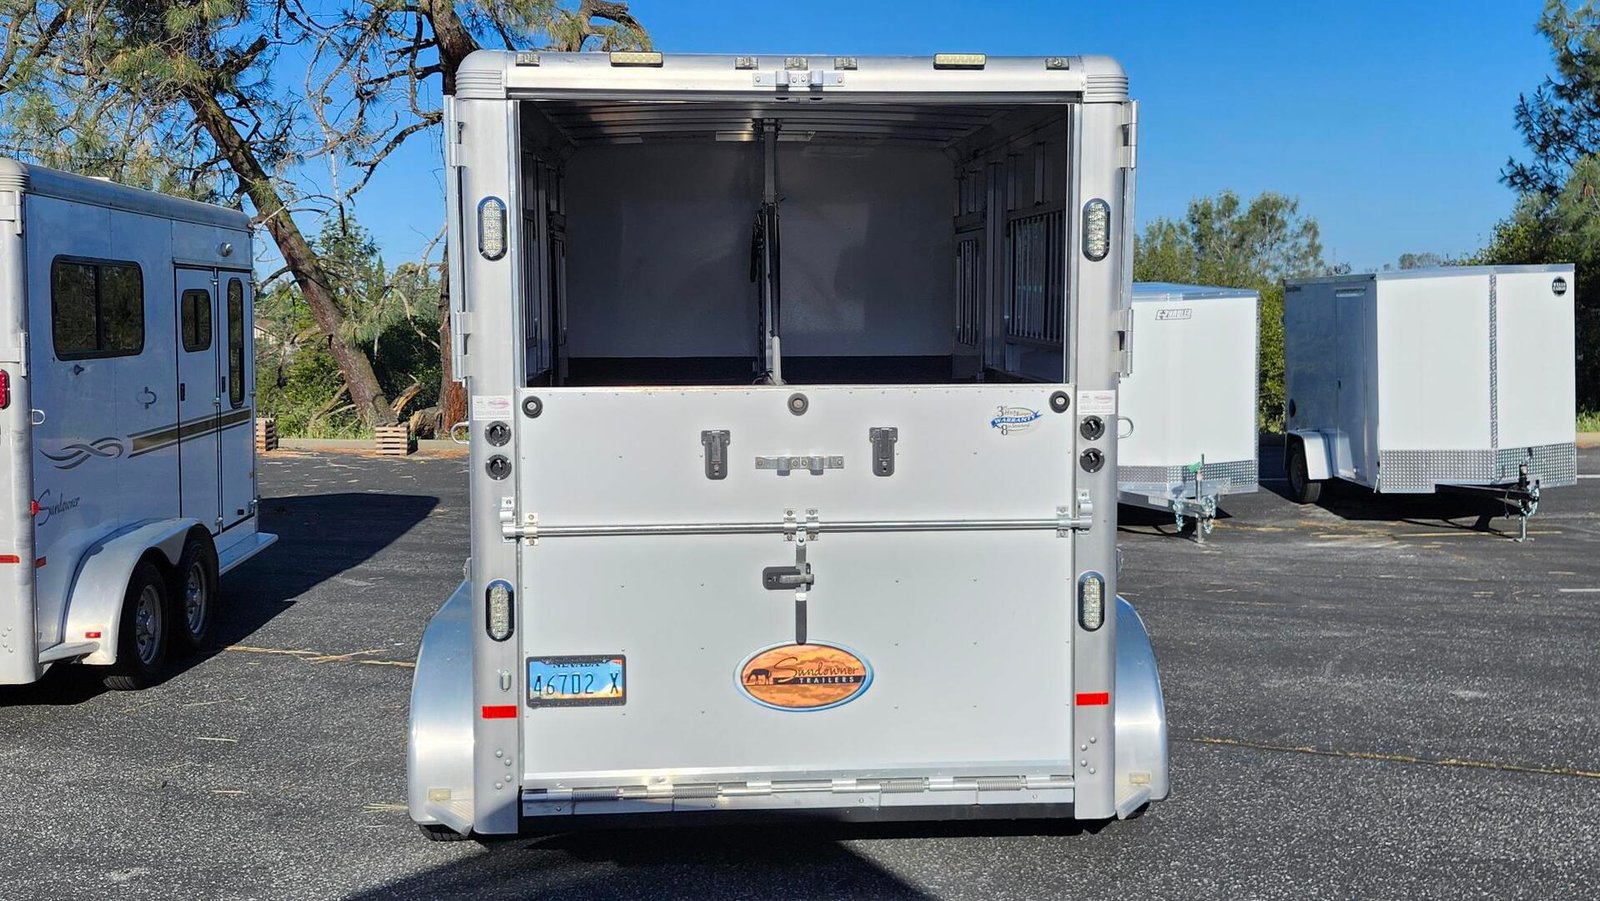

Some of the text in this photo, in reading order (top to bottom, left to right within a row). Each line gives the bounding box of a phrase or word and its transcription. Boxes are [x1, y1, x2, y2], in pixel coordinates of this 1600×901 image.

[994, 415, 1036, 424] WARRANTY
[1001, 425, 1008, 436] 8
[773, 656, 859, 682] Sundowner
[609, 672, 619, 694] X
[799, 676, 855, 684] TRAILERS
